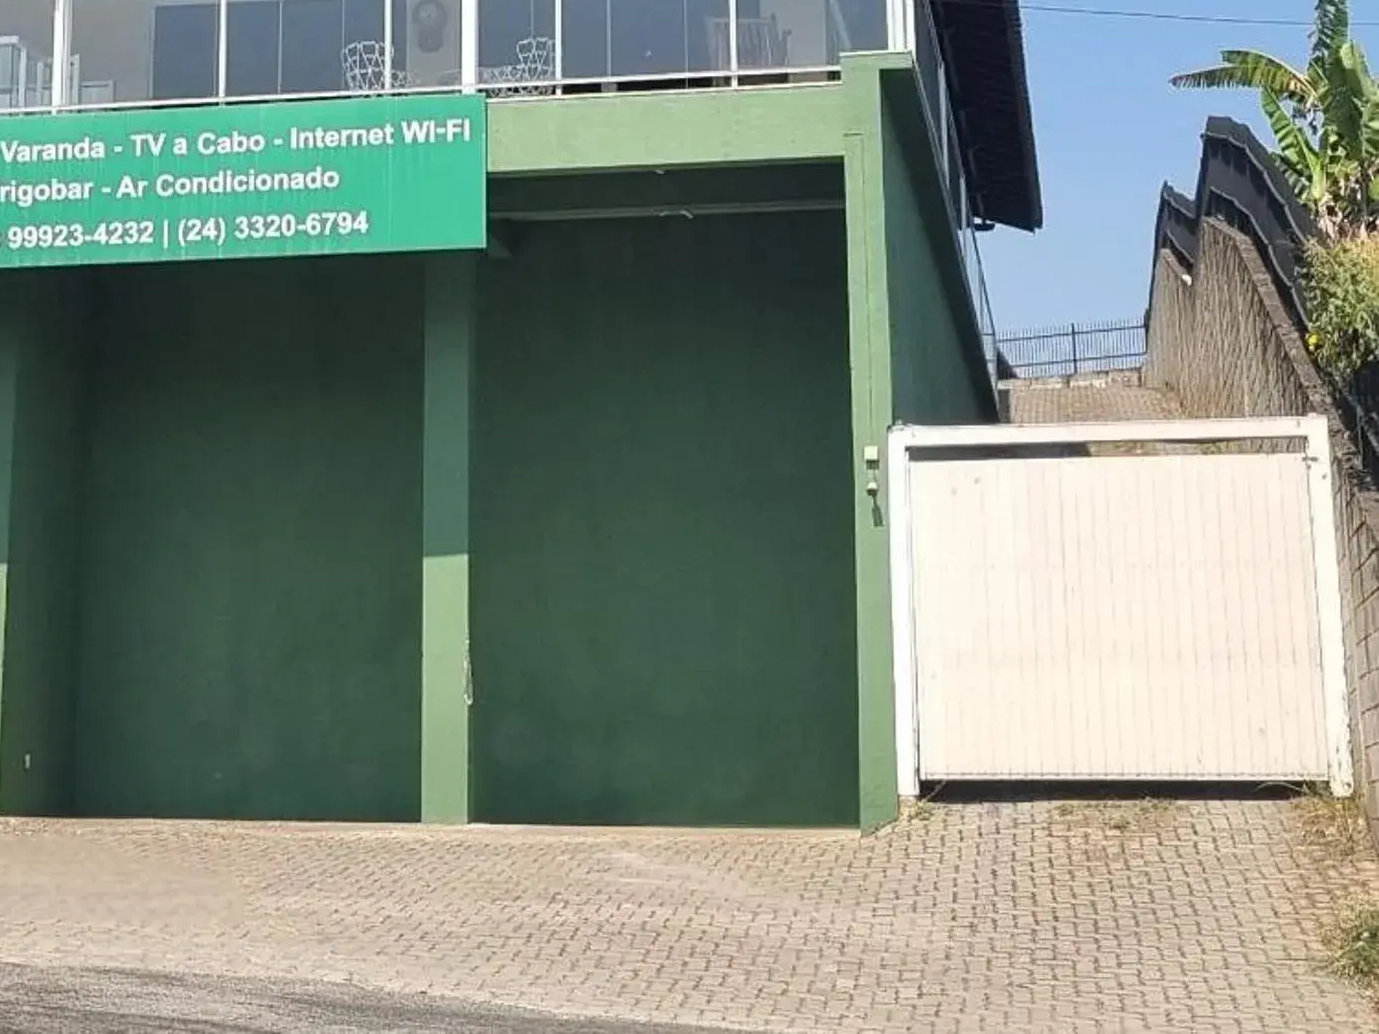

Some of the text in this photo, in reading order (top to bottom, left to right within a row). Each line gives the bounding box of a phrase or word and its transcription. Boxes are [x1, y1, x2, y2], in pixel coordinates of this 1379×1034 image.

[0, 137, 106, 163] Varanda
[131, 134, 167, 157] TV
[173, 137, 188, 155] a
[197, 130, 265, 155] Cabo
[290, 123, 394, 150] Internet
[401, 119, 471, 144] WI-FI
[116, 176, 149, 199] Ar
[155, 166, 340, 197] Condicionado
[8, 220, 154, 250] 99923-4232
[178, 217, 226, 246] (24)
[235, 211, 369, 240] 3320-6794
